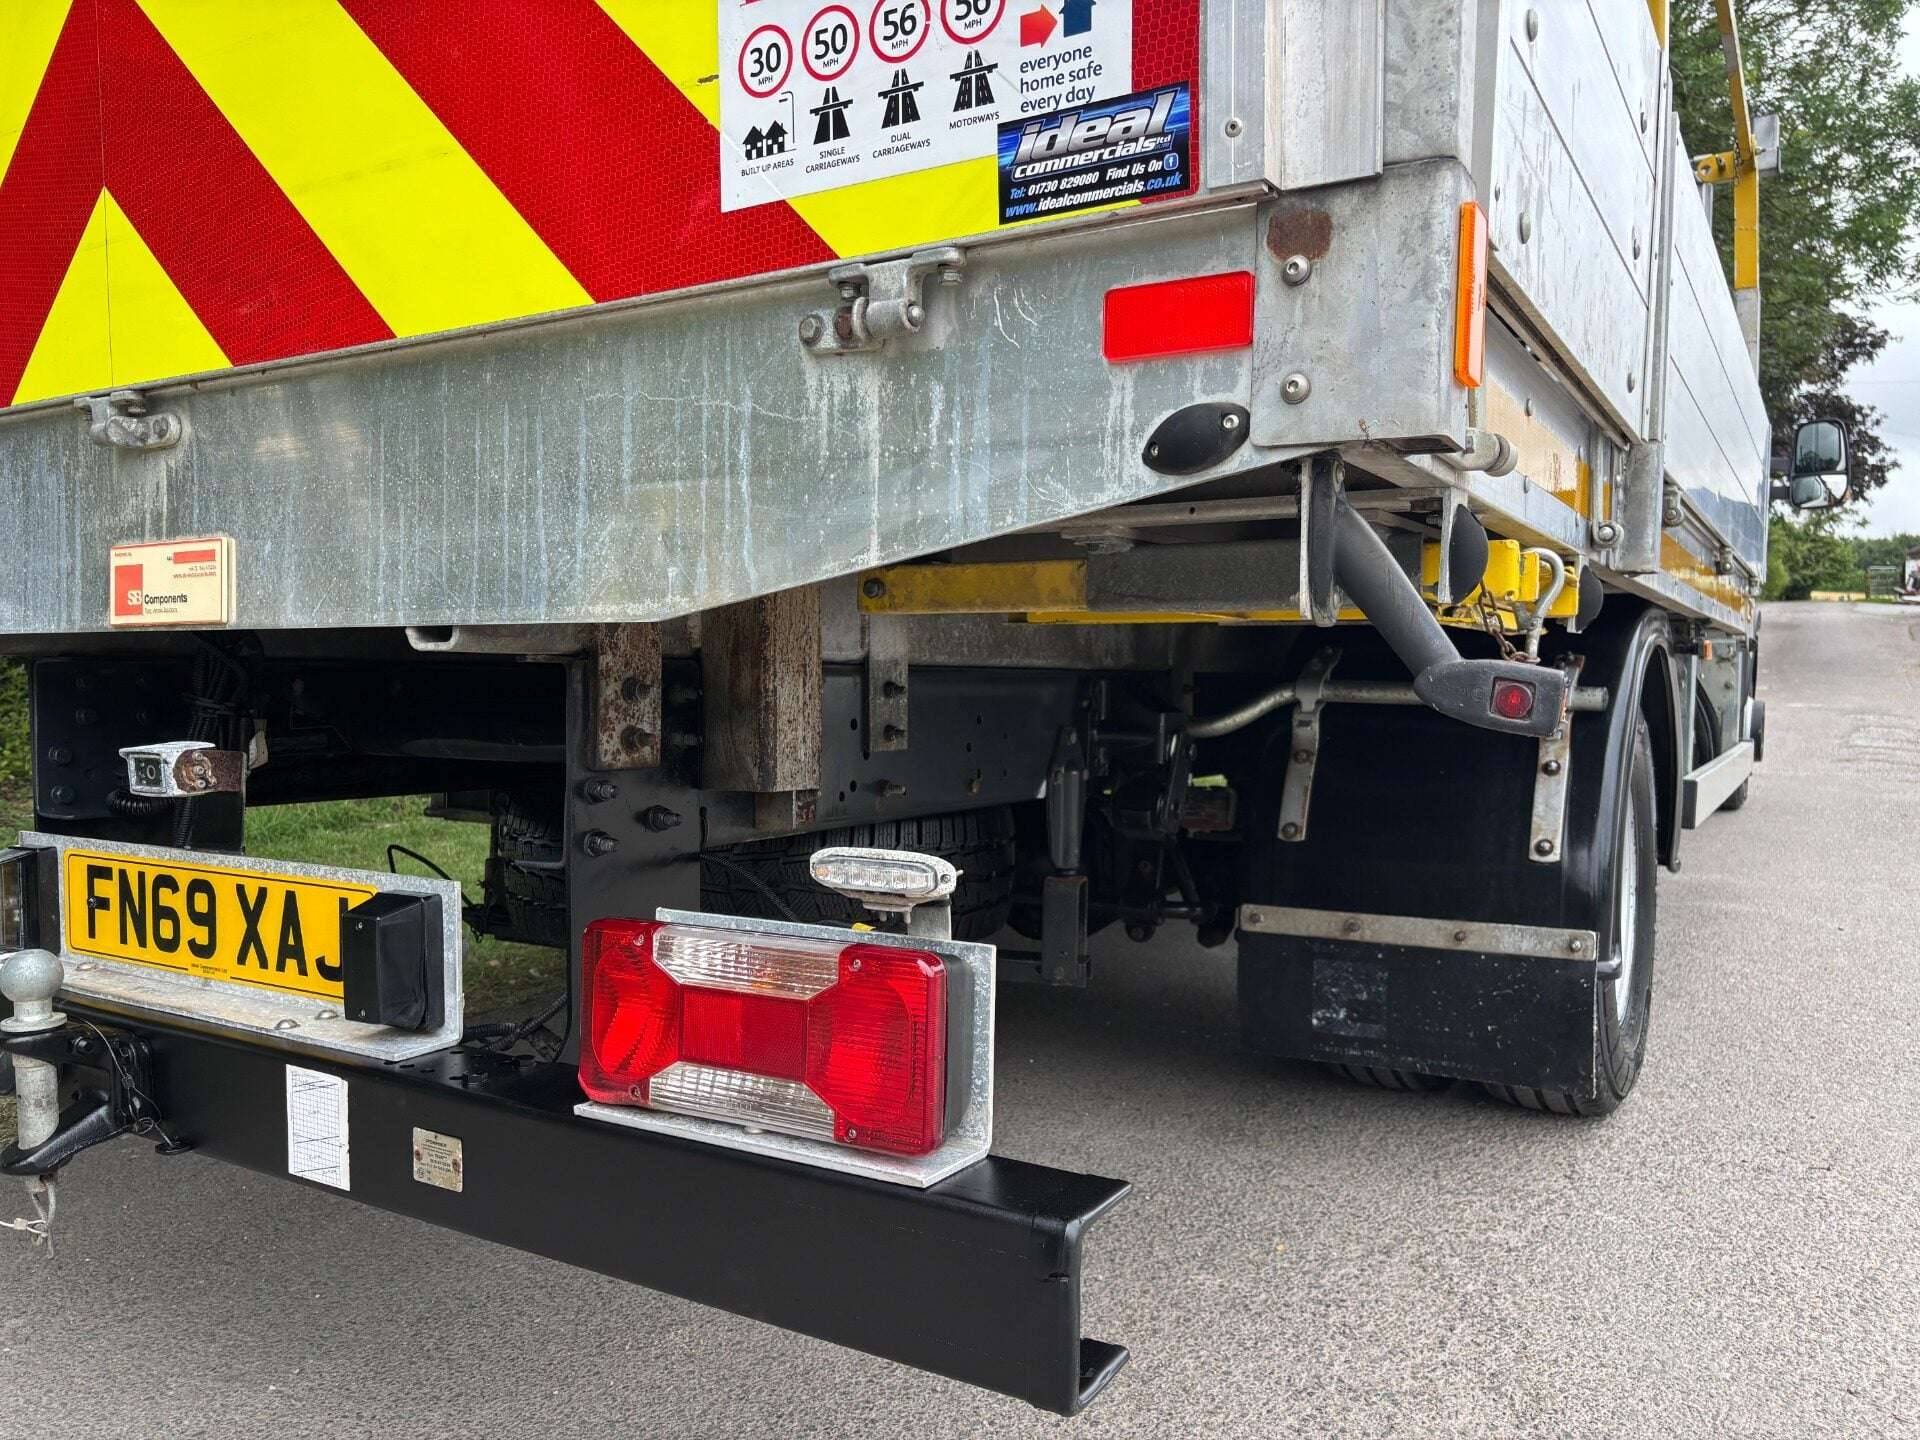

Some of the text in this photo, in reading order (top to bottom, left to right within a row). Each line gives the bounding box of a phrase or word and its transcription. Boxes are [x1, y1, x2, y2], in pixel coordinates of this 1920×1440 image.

[882, 3, 917, 41] 56
[964, 18, 982, 30] MPH
[814, 23, 848, 60] 50
[891, 39, 908, 50] MPH
[750, 42, 781, 78] 30
[823, 58, 839, 69] MPH
[1020, 46, 1093, 75] everyone
[758, 75, 774, 86] MPH
[1020, 62, 1102, 94] home safe
[1020, 84, 1096, 114] every day
[949, 111, 1000, 130] MOTORWAYS
[1014, 89, 1179, 164] ideal
[872, 138, 931, 159] CARRIAGEWAYS
[890, 131, 911, 143] DUAL
[805, 154, 860, 174] CARRIAGEWAYS
[819, 146, 845, 159] SINGLE
[1014, 136, 1157, 179] commercials
[741, 158, 794, 177] BUILT UP AREAS
[1010, 187, 1026, 200] Tel:
[1028, 181, 1057, 197] 01730
[1060, 171, 1099, 190] 829080
[1106, 166, 1128, 181] Find
[1132, 163, 1145, 175] Us
[1148, 159, 1162, 172] On
[1006, 171, 1182, 218] www.idealcommercials.co.uk
[144, 593, 188, 606] Components
[86, 864, 344, 982] FN69 XAJ
